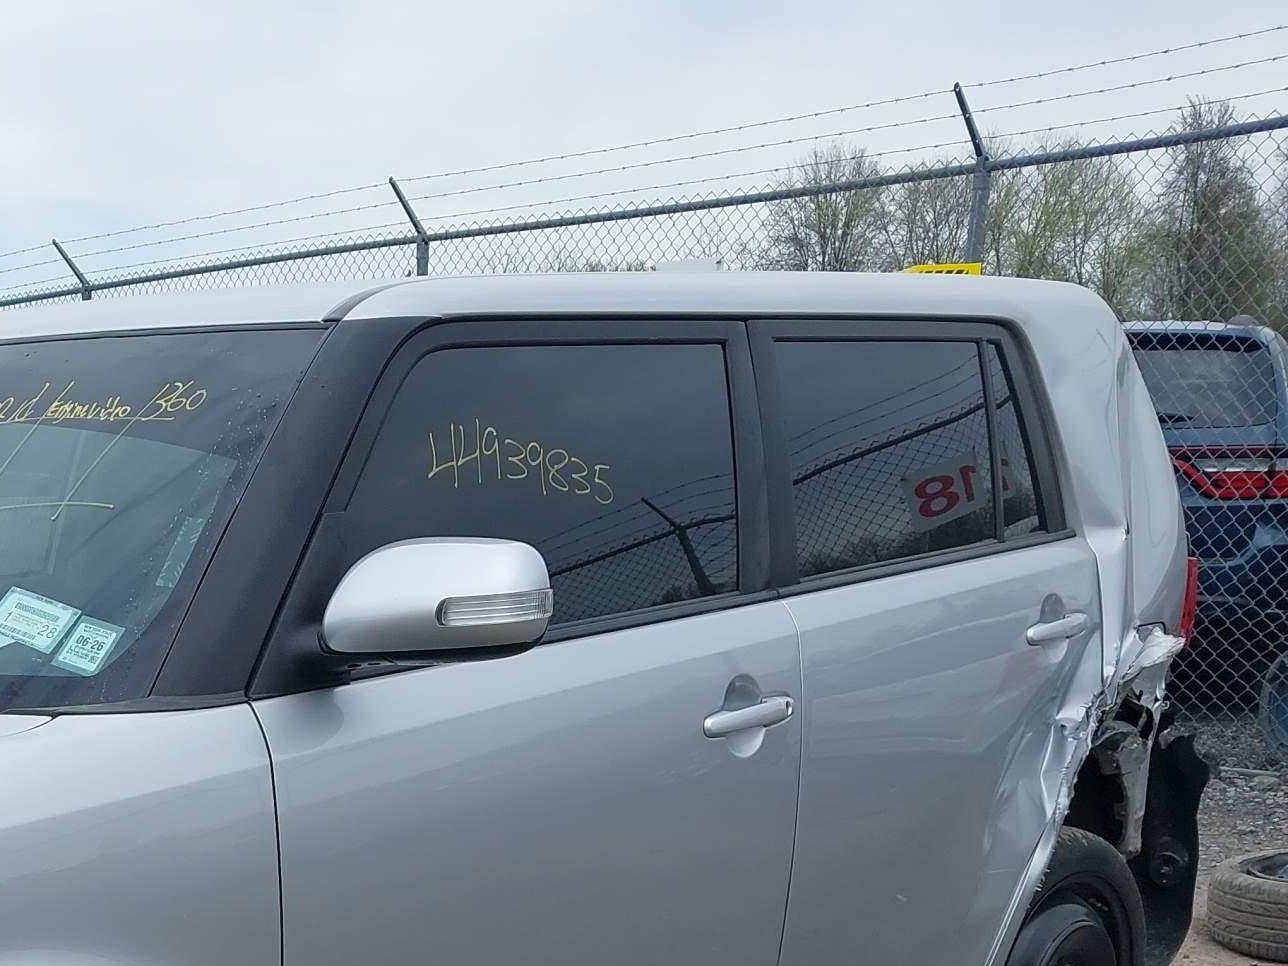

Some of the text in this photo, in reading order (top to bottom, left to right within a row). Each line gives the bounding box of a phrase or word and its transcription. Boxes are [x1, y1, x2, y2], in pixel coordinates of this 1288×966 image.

[427, 417, 614, 504] 44939835
[37, 624, 58, 639] 28
[76, 635, 105, 652] 06-26
